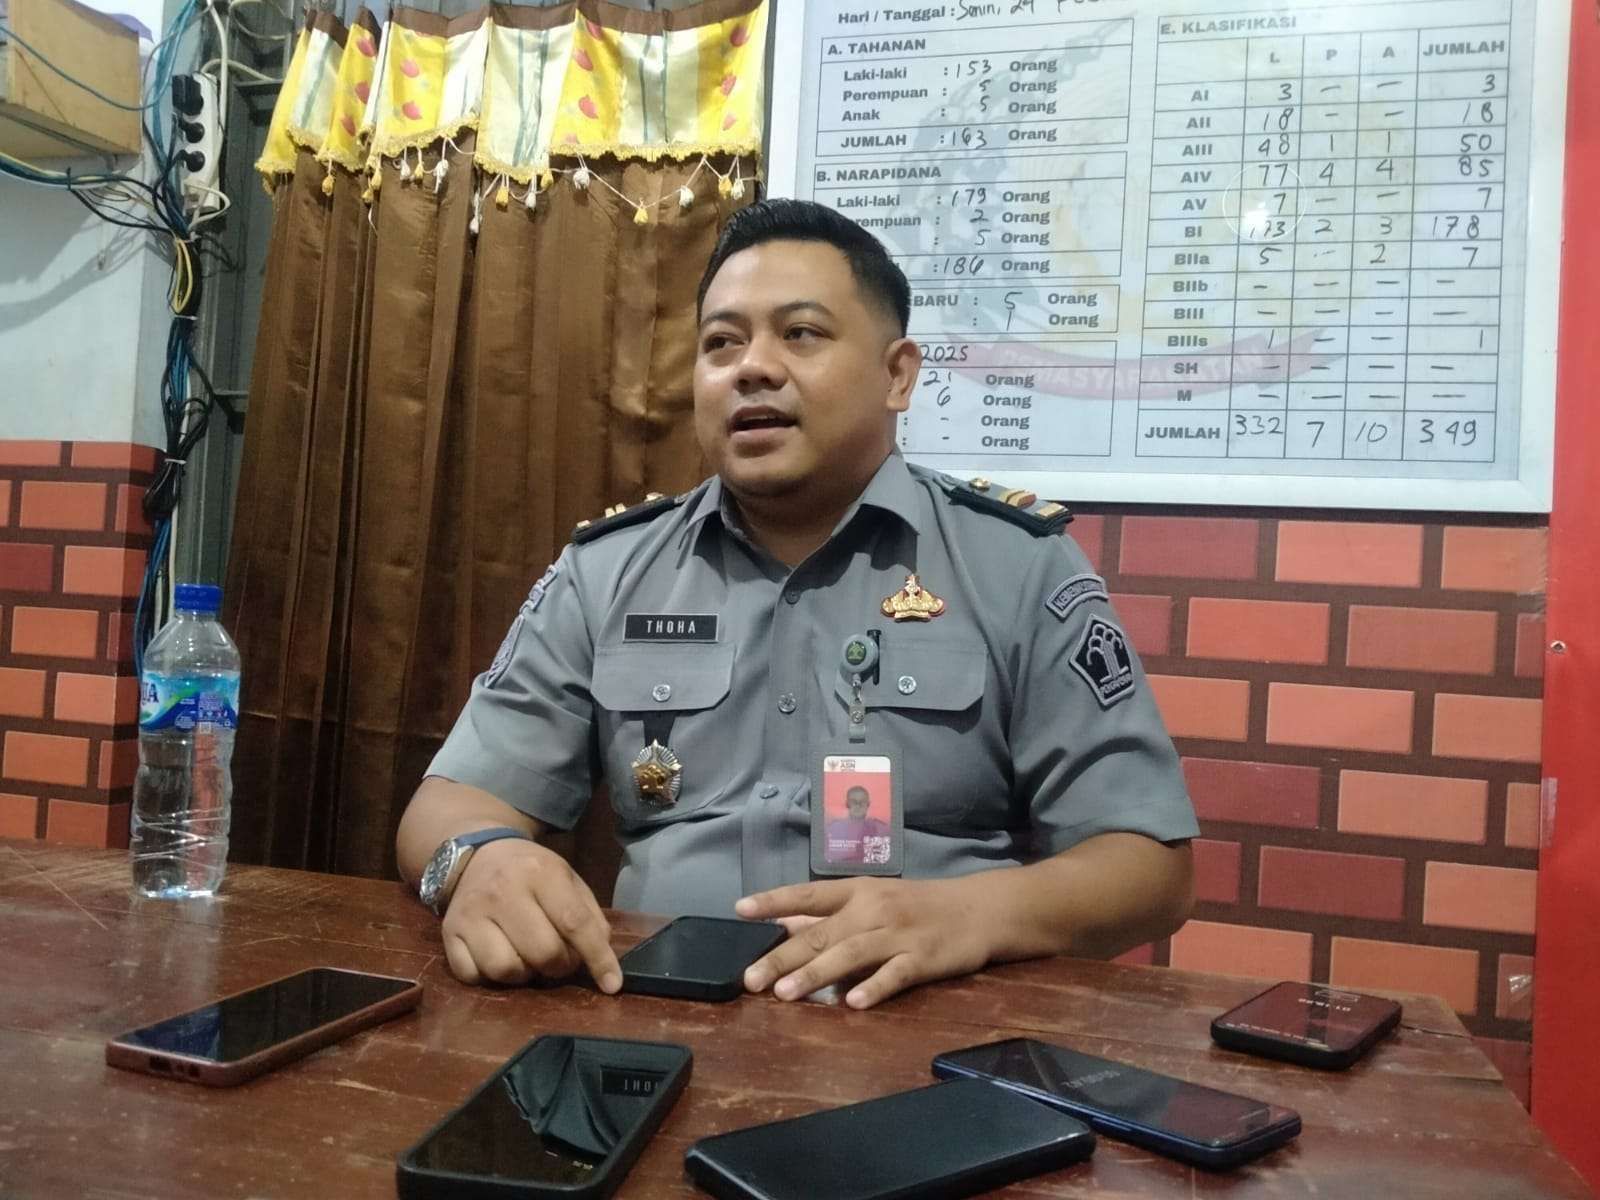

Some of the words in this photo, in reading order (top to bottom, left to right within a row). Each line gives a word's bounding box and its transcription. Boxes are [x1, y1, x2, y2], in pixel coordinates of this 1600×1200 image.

[838, 12, 870, 24] Hari
[874, 11, 879, 23] /
[883, 6, 946, 22] Tanggal
[1160, 23, 1177, 35] E.
[1182, 16, 1297, 34] KLASIFIKASI
[828, 44, 842, 56] A.
[848, 38, 926, 54] TAHANAN
[1270, 51, 1280, 64] L
[1326, 50, 1337, 61] P
[1383, 46, 1395, 59] A
[1423, 40, 1505, 57] JUMLAH
[843, 67, 907, 81] Laki-laki
[956, 60, 992, 78] 153
[1010, 60, 1058, 75] Orang
[843, 87, 928, 105] Perempuan
[979, 79, 991, 92] 5
[1008, 80, 1058, 95] Orang
[1191, 89, 1209, 102] AI
[1280, 83, 1292, 100] 3
[1482, 74, 1495, 92] 3
[842, 108, 880, 122] Anak
[980, 96, 991, 112] 5
[1008, 101, 1057, 116] Orang
[1186, 116, 1211, 129] AII
[1263, 107, 1294, 130] 18
[1462, 101, 1494, 124] 18
[840, 134, 907, 148] JUMLAH
[952, 128, 987, 150] 163
[1008, 129, 1057, 143] Orang
[1181, 143, 1213, 157] AIII
[1258, 133, 1290, 156] 48
[1460, 133, 1492, 150] 50
[816, 170, 831, 182] B.
[836, 166, 942, 182] NARAPIDANA
[1180, 171, 1212, 184] AIV
[1258, 163, 1288, 186] 77
[1319, 162, 1335, 185] 4
[1375, 159, 1394, 180] 4
[1459, 156, 1494, 177] 85
[836, 194, 900, 208] Laki-laki
[951, 188, 987, 207] 179
[1002, 190, 1050, 205] Orang
[1182, 199, 1207, 211] AV
[1273, 193, 1287, 214] 7
[1478, 187, 1492, 209] 7
[970, 209, 988, 224] 2
[1002, 210, 1050, 225] Orang
[1185, 226, 1202, 239] BI
[1314, 219, 1335, 234] 2
[1380, 216, 1392, 235] 3
[1431, 216, 1480, 239] 178
[975, 229, 991, 246] 5
[1001, 231, 1050, 246] Orang
[1173, 253, 1210, 265] BIIa
[1259, 248, 1283, 265] 5
[1370, 243, 1385, 264] 2
[1462, 247, 1479, 267] 7
[1001, 259, 1050, 274] Orang
[1172, 279, 1209, 293] BIIb
[913, 295, 959, 307] BARU
[1003, 292, 1023, 311] 5
[1048, 293, 1098, 307] Orang
[1048, 313, 1099, 328] Orang
[1173, 308, 1204, 320] BIII
[921, 344, 968, 362] 2025
[1173, 362, 1199, 375] SH
[985, 374, 1035, 389] Orang
[937, 386, 951, 407] 6
[983, 394, 1032, 409] Orang
[1177, 390, 1192, 402] M
[981, 415, 1030, 430] Orang
[1145, 426, 1220, 440] JUMLAH
[1235, 415, 1284, 436] 332
[1306, 421, 1325, 448] 7
[1355, 421, 1388, 443] 10
[1419, 419, 1477, 446] 349
[982, 435, 1030, 451] Orang
[646, 620, 696, 634] THOHA
